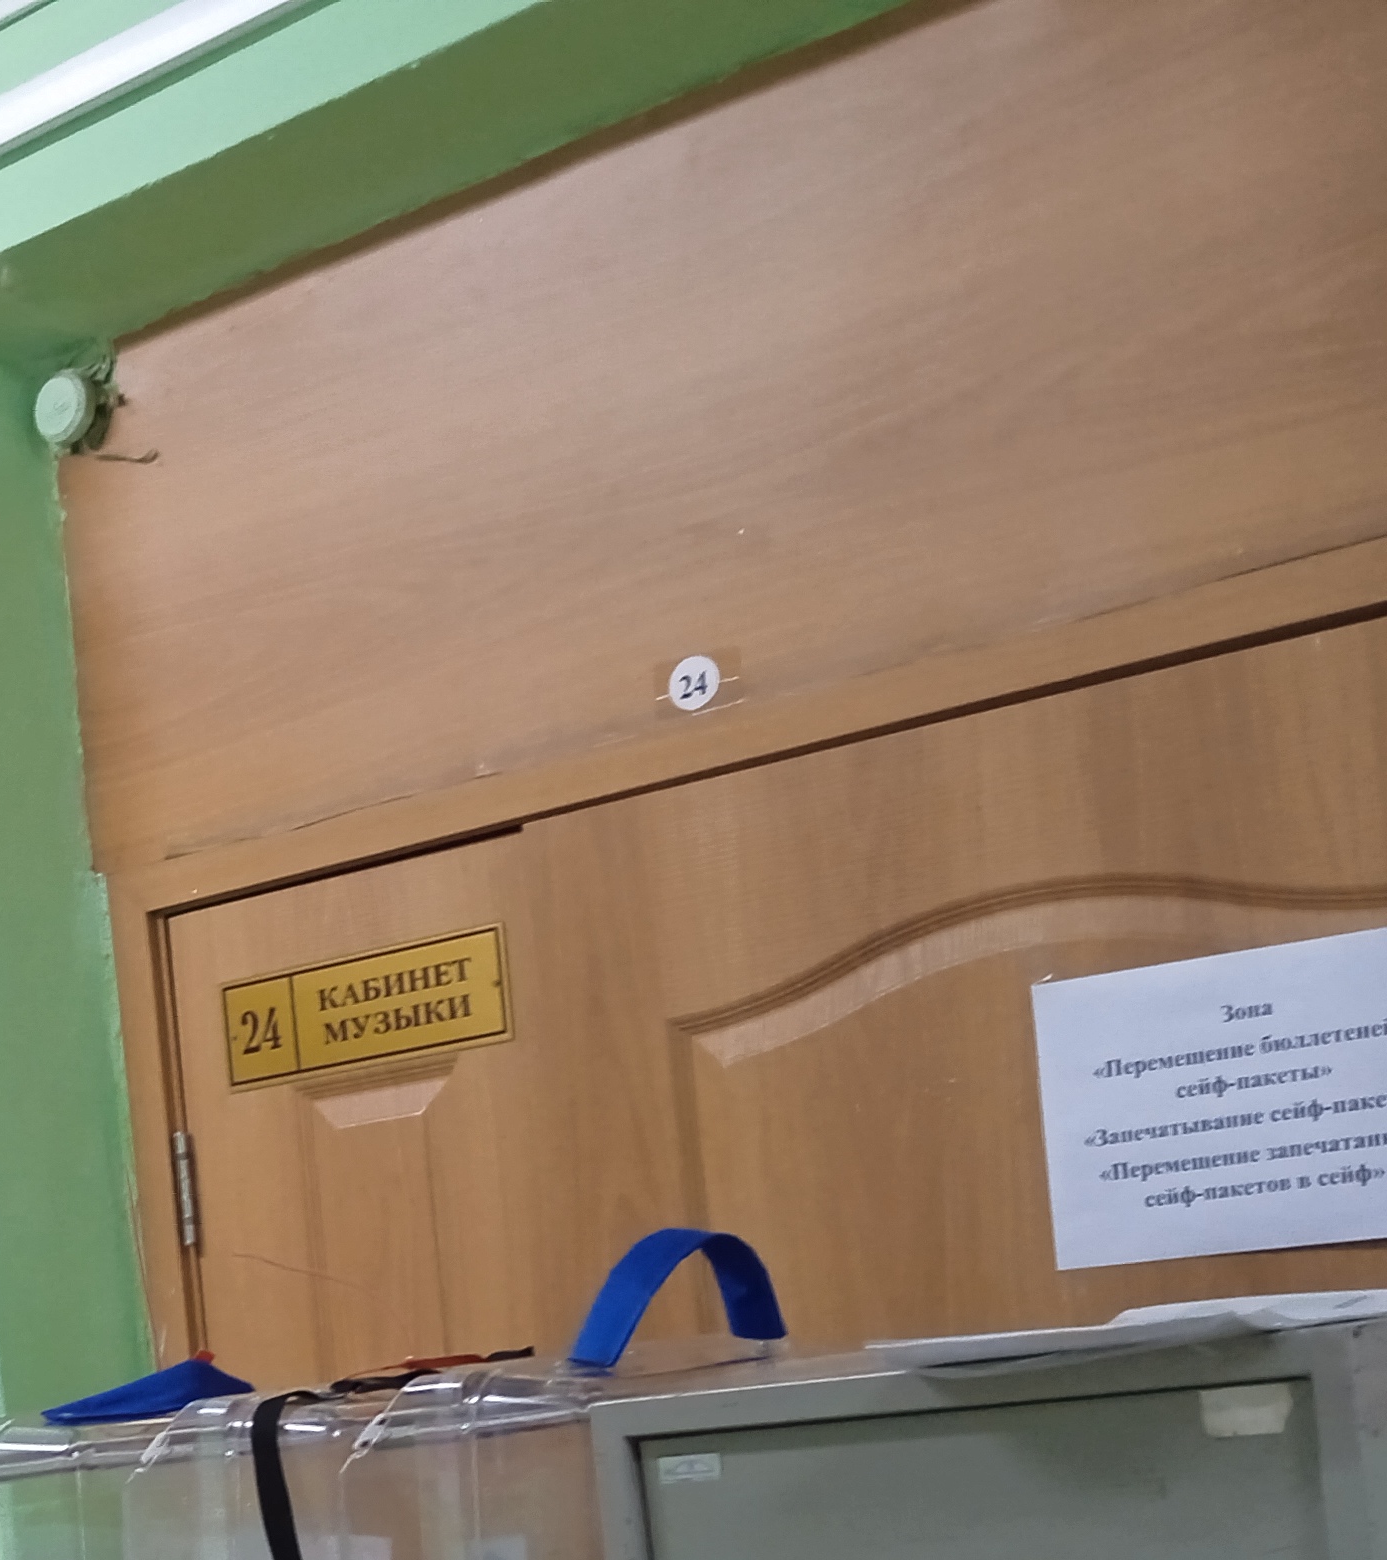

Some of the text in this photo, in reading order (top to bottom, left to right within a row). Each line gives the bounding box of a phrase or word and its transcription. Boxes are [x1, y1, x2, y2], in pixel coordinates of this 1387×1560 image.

[679, 670, 708, 700] 24
[318, 956, 472, 1012] КАБИНЕТ
[241, 994, 473, 1055] 24 МУЗЫКИ
[1221, 1002, 1273, 1023] Зона
[1176, 1066, 1333, 1100] сейф-пакеты»
[1084, 1110, 1265, 1148] «Запечатывание
[1144, 1163, 1386, 1208] сейф-пакетов в сейф»
